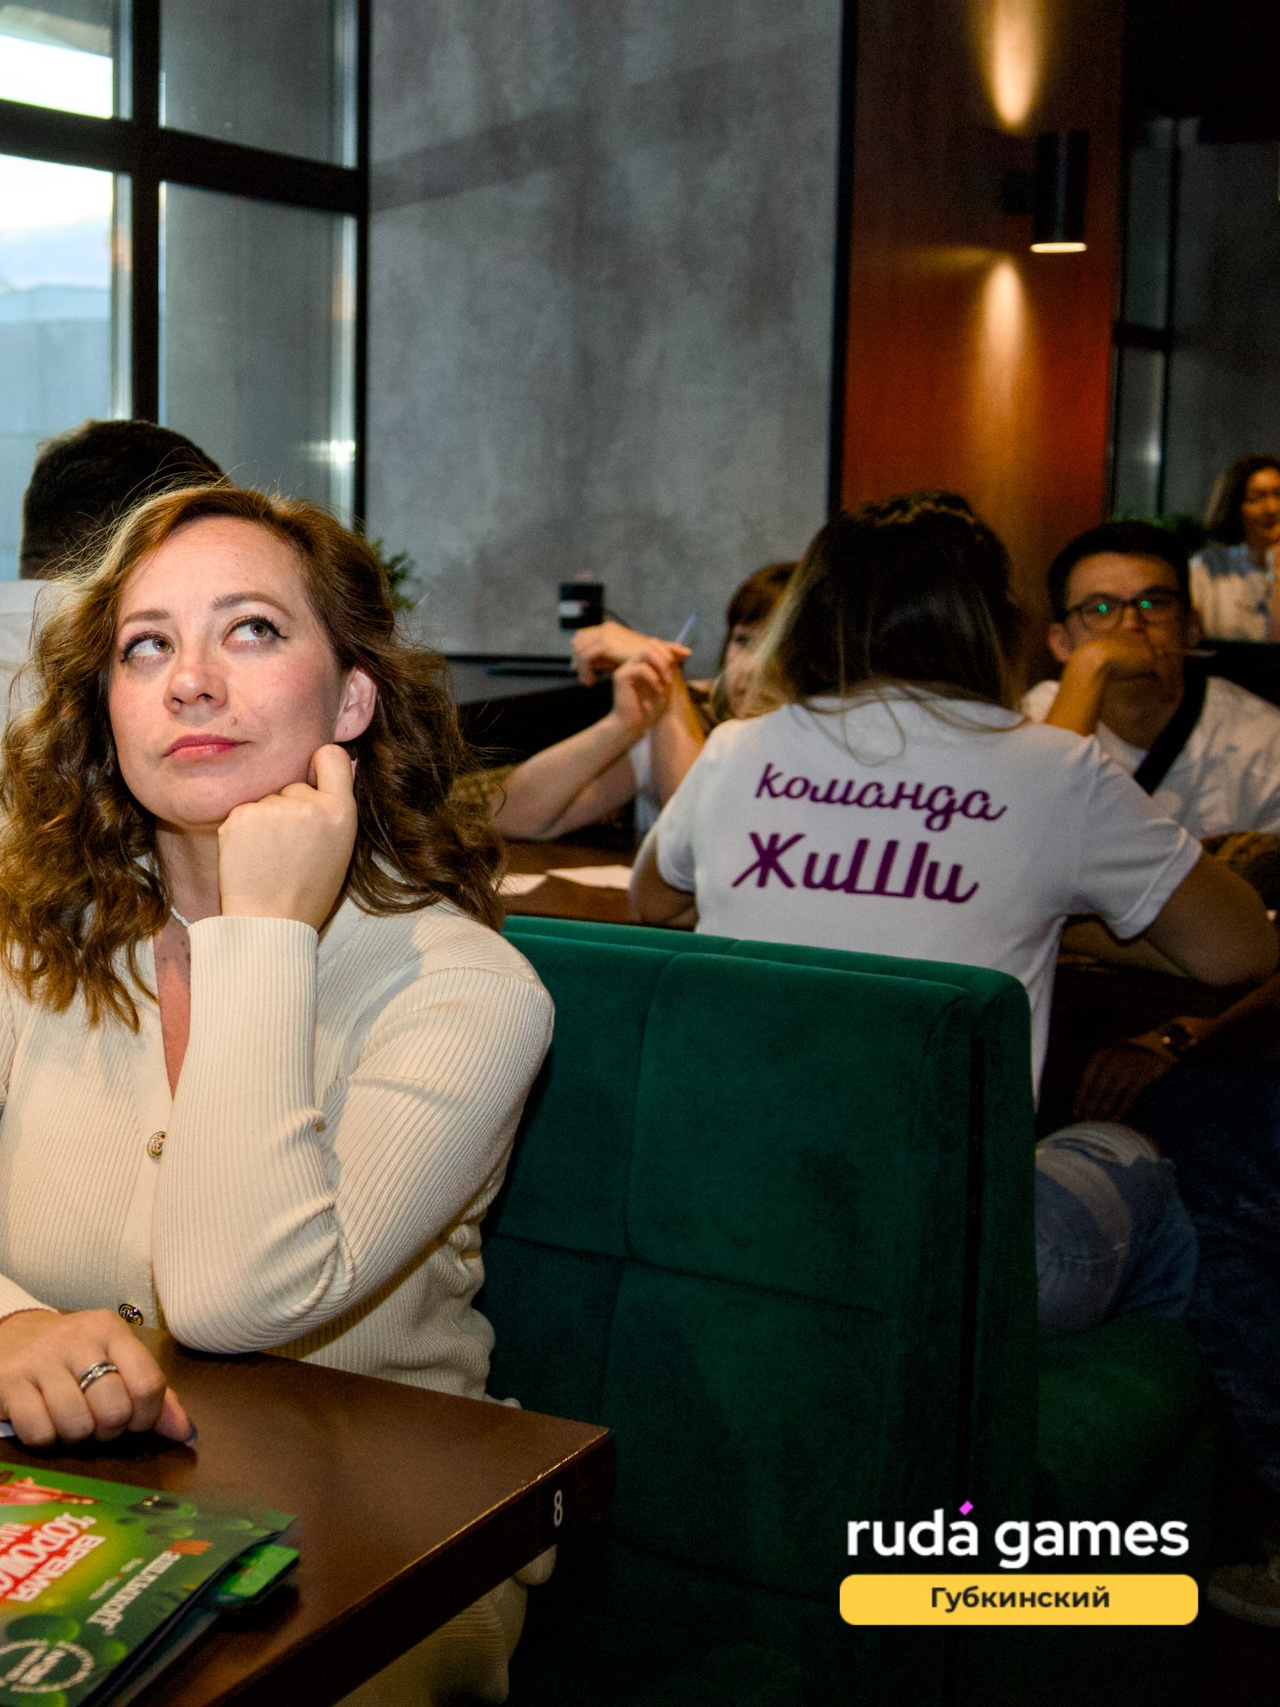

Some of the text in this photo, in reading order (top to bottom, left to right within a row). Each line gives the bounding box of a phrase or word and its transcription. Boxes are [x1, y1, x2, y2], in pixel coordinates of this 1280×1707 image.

[754, 762, 1008, 832] команда
[731, 831, 980, 904] ЖиШи
[553, 1489, 563, 1528] 8
